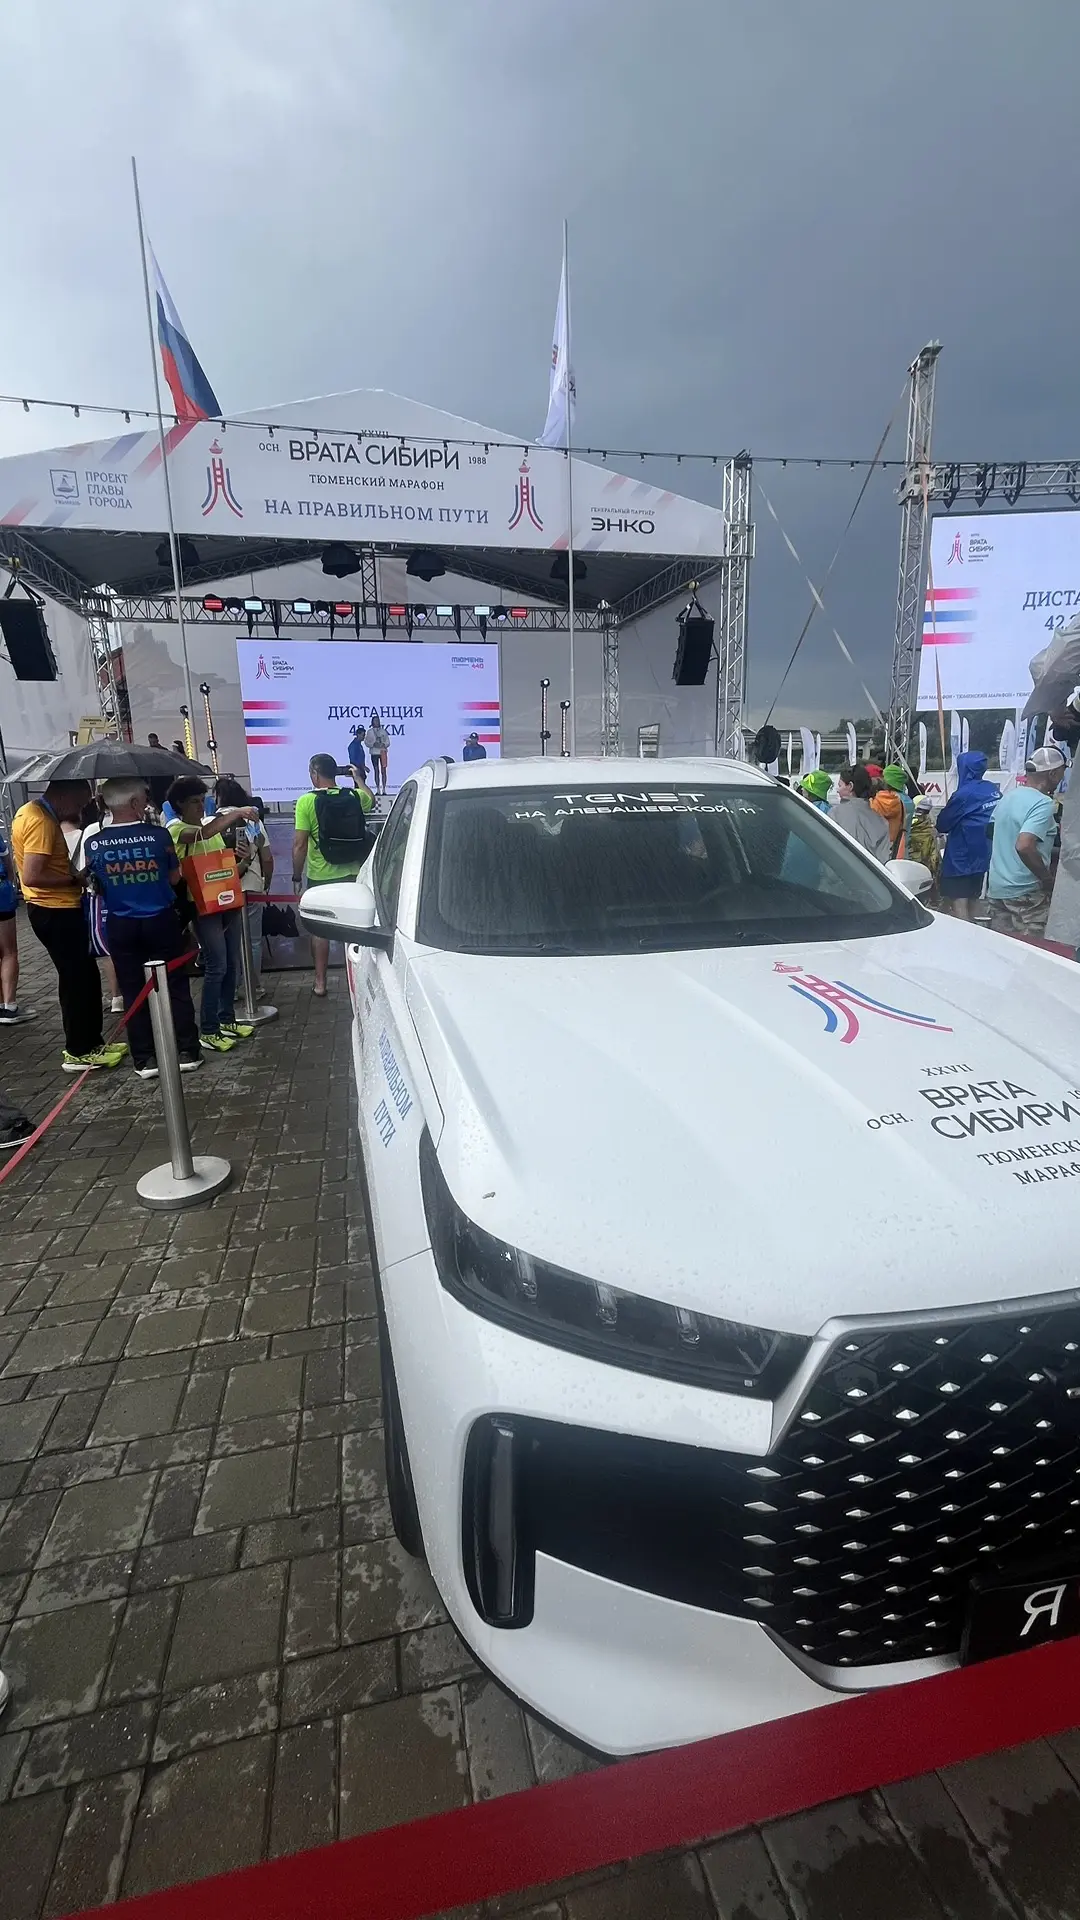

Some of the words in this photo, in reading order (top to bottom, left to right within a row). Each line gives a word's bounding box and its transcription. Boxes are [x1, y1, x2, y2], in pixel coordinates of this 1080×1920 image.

[259, 442, 282, 452] ОСН.
[289, 440, 360, 464] ВРАТА
[365, 445, 459, 470] СИБИРИ
[468, 456, 487, 464] 1988
[85, 471, 128, 484] ПРОЕКТ
[309, 474, 386, 487] ТЮМЕНСКИЙ
[389, 478, 444, 490] МАРАФОН
[87, 484, 124, 496] ГЛАВЫ
[89, 496, 133, 509] ГОРОДА
[265, 499, 292, 515] НА
[298, 501, 434, 521] ПРАВИЛЬНОМ
[439, 508, 489, 524] ПУТИ
[591, 517, 655, 534] ЭНКО
[327, 706, 423, 720] ДИСТАНЦИЯ
[553, 793, 705, 804] TENET
[515, 810, 546, 819] НА
[99, 835, 156, 846] ЧЕЛИНДБАНК
[103, 847, 156, 861] CHEL
[105, 860, 159, 874] MARA
[108, 871, 159, 886] THON
[920, 1063, 974, 1077] XXVII
[918, 1079, 1037, 1109] ВРАТА
[373, 1098, 396, 1148] ПУТИ
[866, 1112, 914, 1130] ОСН.
[930, 1100, 1080, 1140] СИБИРИ
